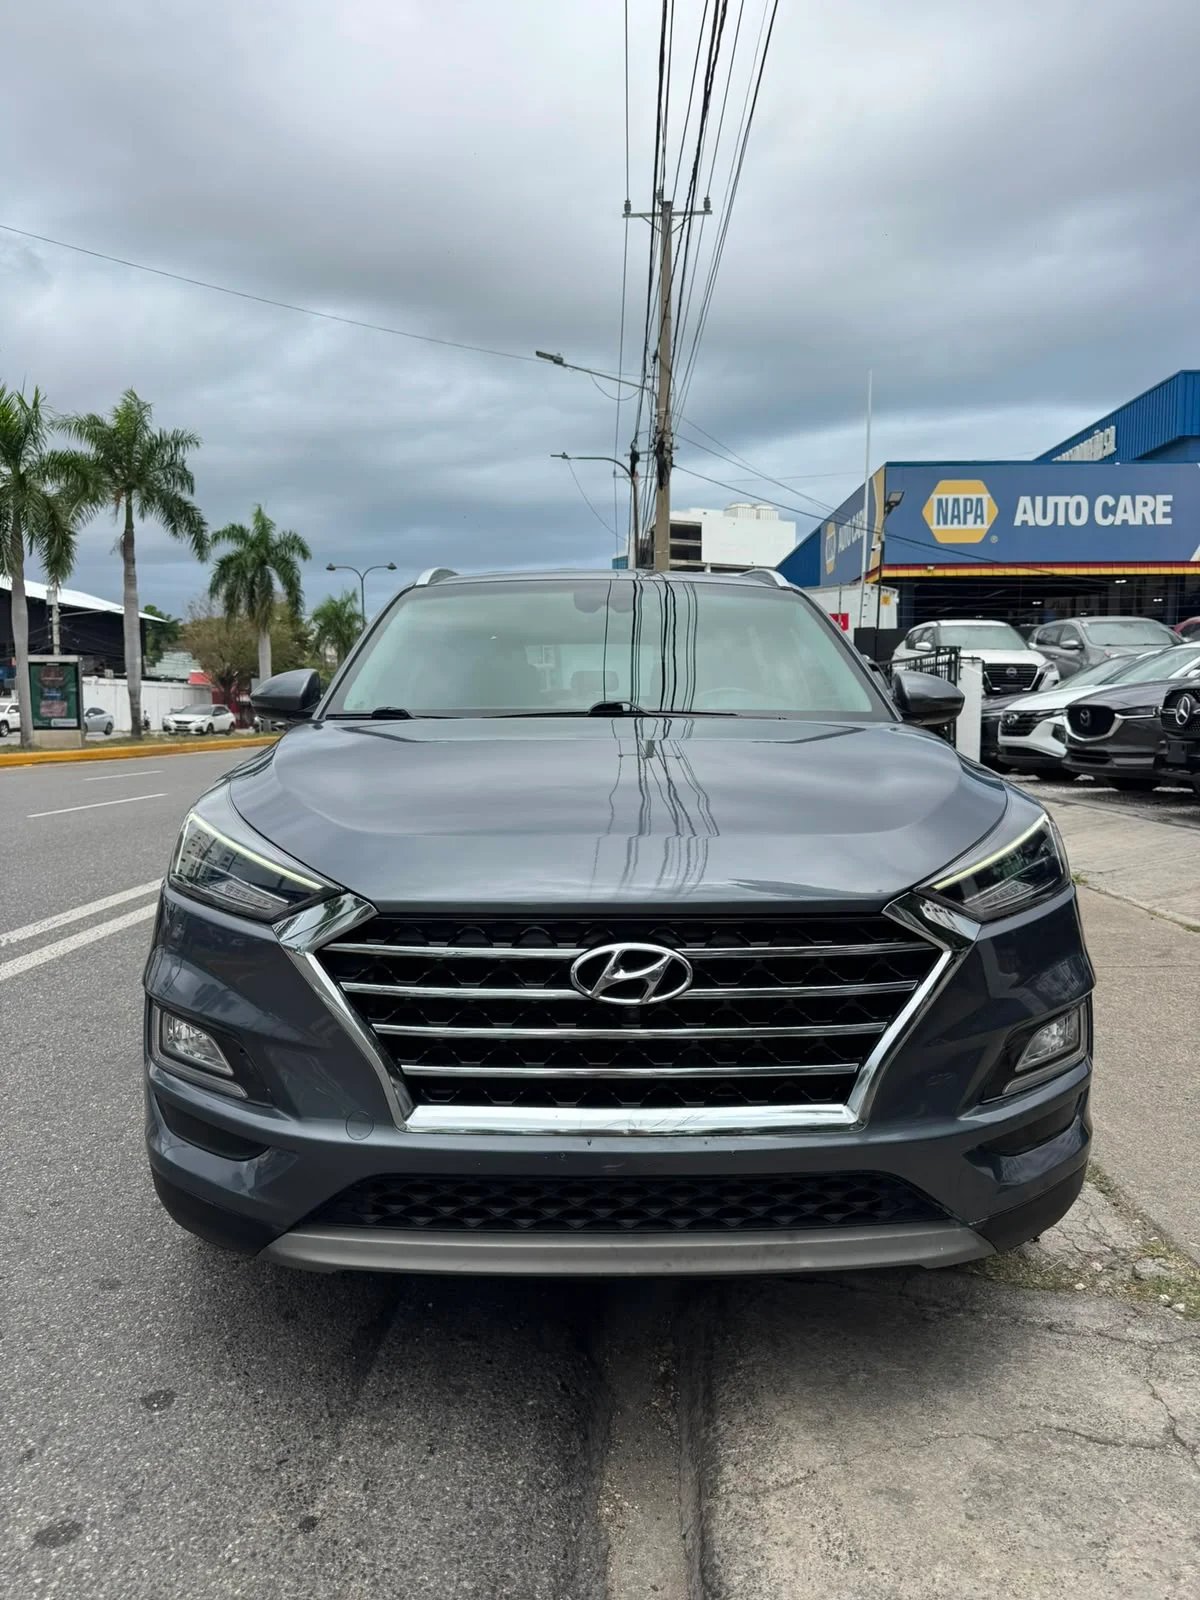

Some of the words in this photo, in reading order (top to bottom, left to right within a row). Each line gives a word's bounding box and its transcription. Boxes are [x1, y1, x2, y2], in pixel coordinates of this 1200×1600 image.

[936, 497, 985, 526] NAPA
[1013, 495, 1089, 526] AUTO
[1094, 494, 1173, 526] CARE
